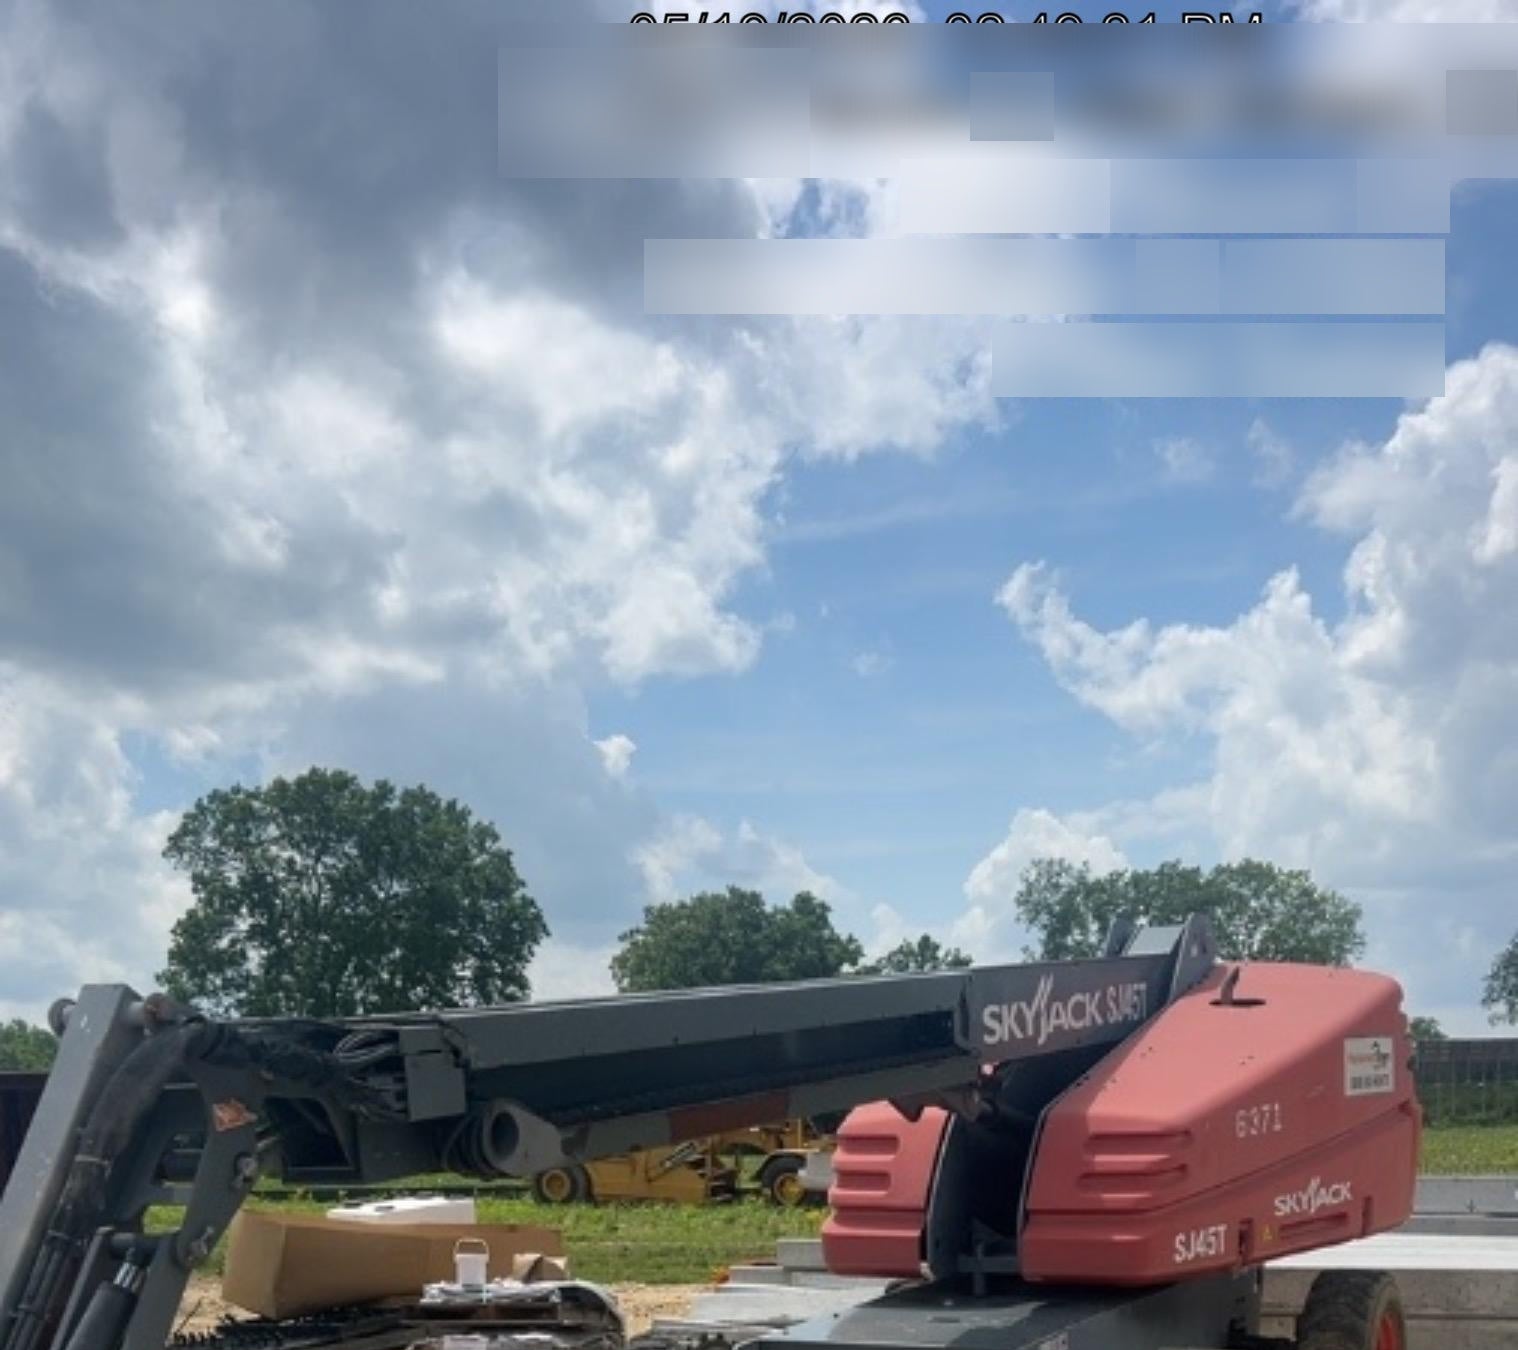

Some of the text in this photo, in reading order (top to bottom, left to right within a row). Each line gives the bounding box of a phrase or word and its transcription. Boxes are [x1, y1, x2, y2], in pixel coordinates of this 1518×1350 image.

[983, 974, 1103, 1046] SKYJACK
[1235, 1103, 1282, 1138] 6371
[1274, 1176, 1354, 1216] SKYJACK
[1174, 1223, 1228, 1263] SJ45T
